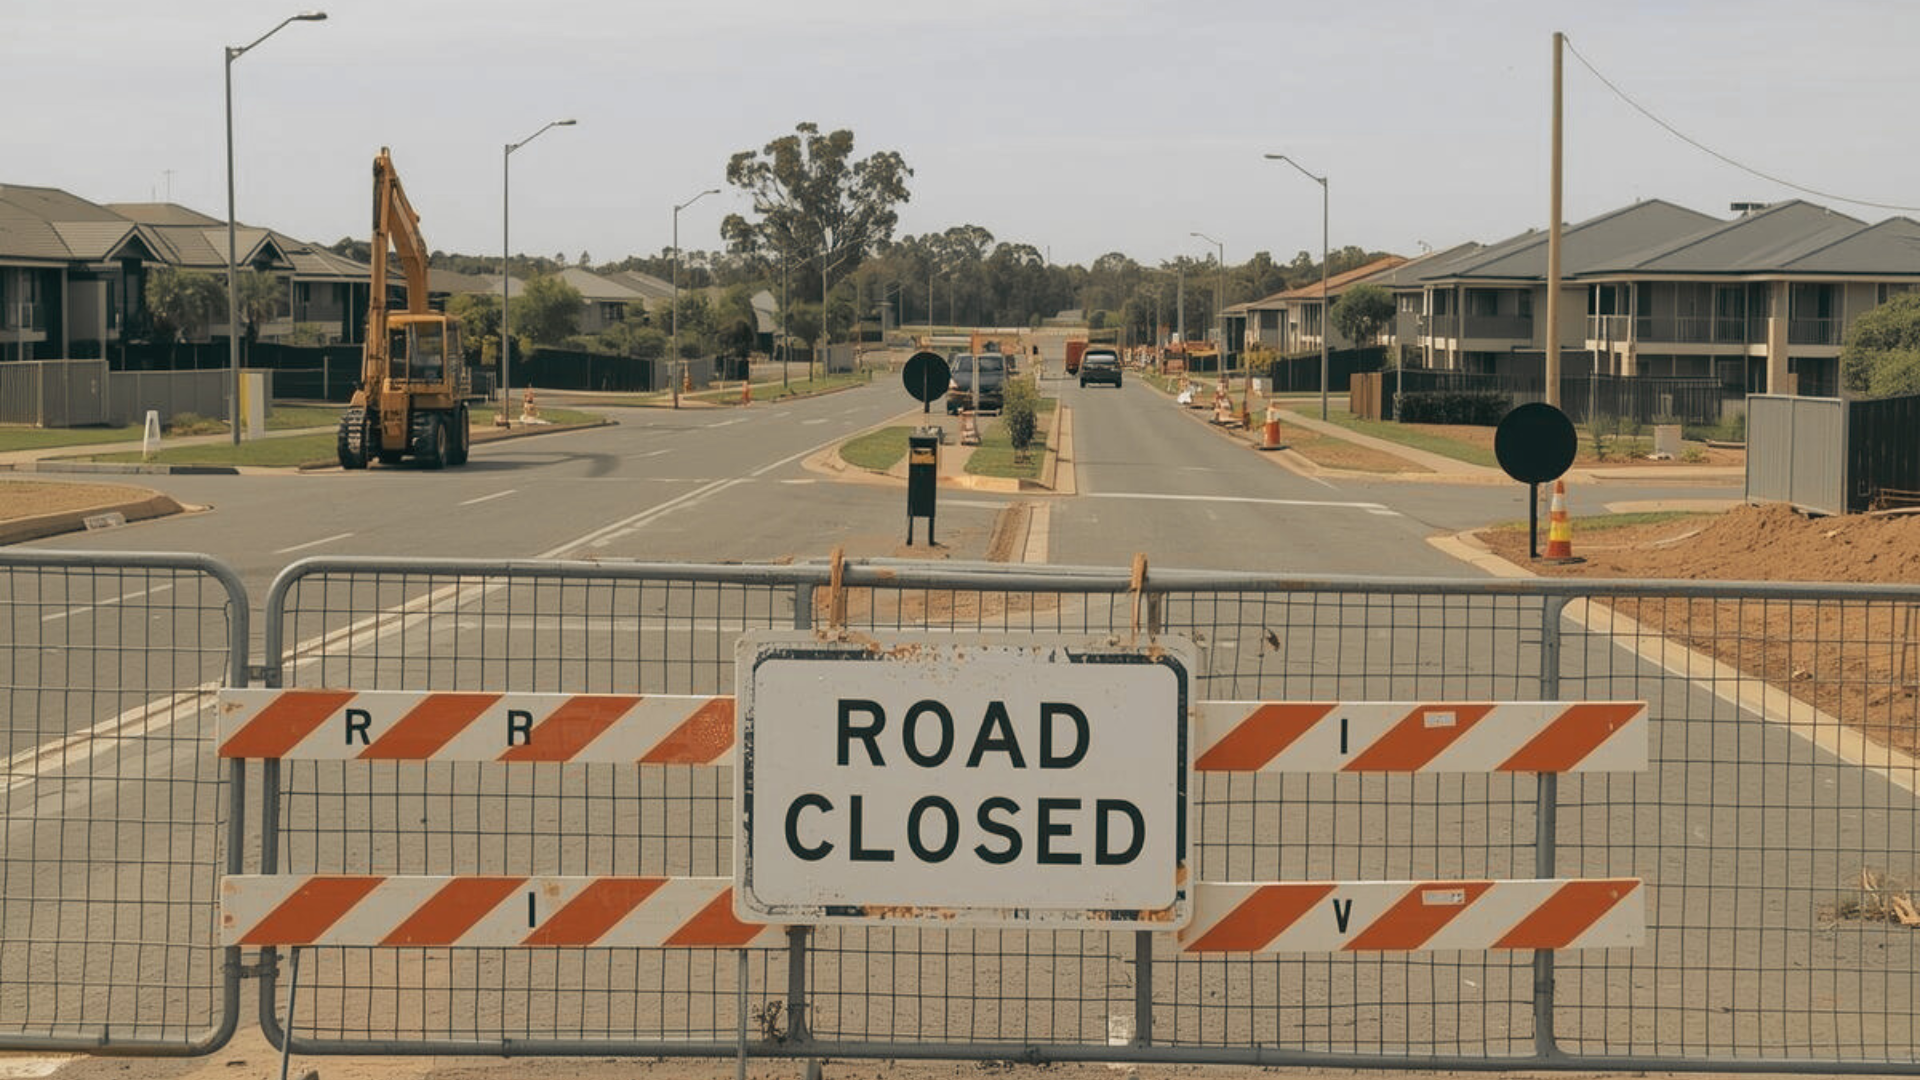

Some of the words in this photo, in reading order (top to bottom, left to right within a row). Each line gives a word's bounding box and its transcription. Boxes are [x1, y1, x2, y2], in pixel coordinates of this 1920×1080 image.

[345, 708, 372, 746] R
[507, 709, 534, 747] R
[837, 699, 1090, 770] ROAD
[784, 793, 1146, 866] CLOSED
[1332, 898, 1353, 934] V
